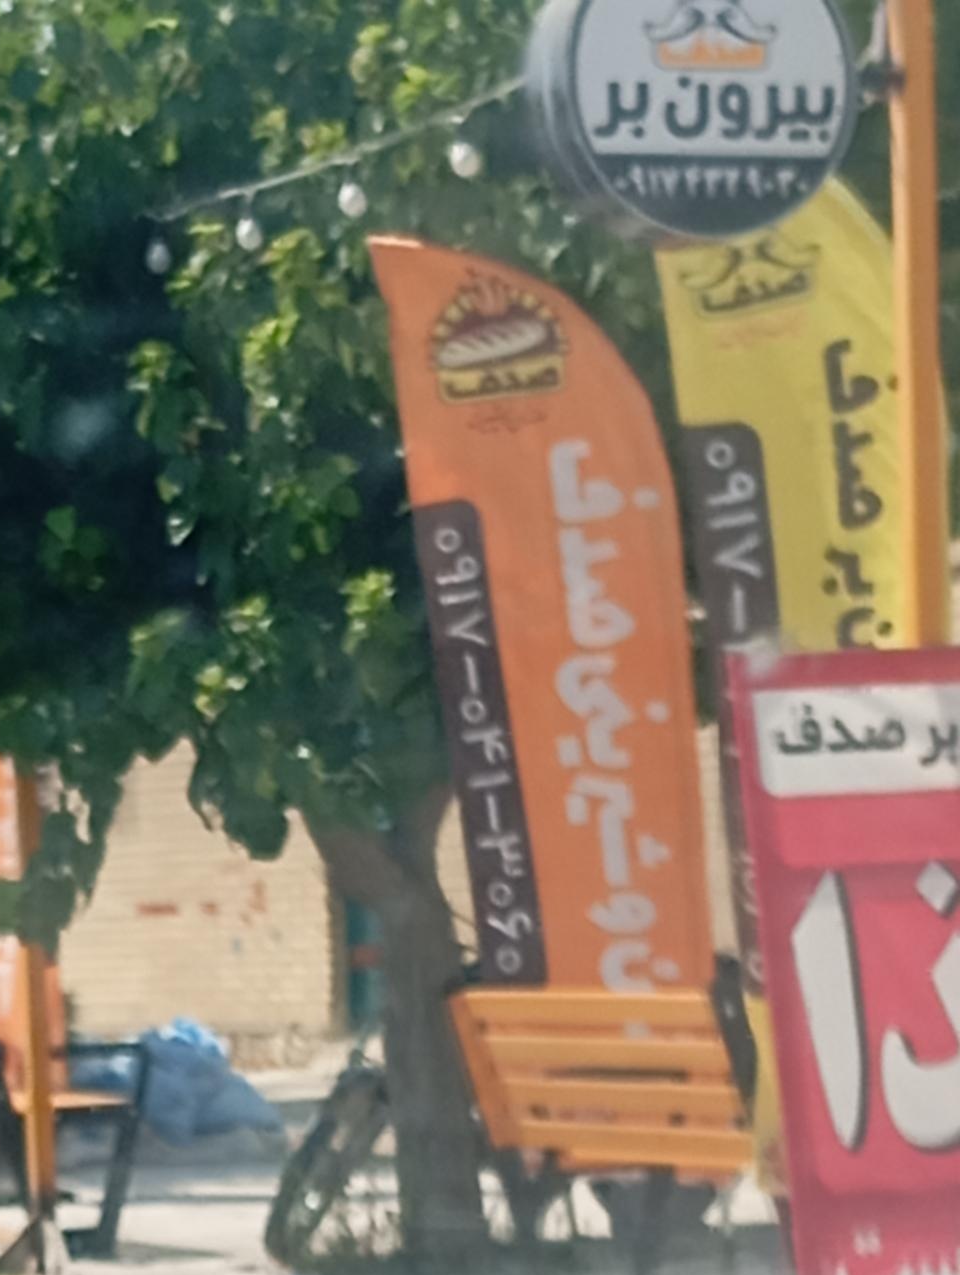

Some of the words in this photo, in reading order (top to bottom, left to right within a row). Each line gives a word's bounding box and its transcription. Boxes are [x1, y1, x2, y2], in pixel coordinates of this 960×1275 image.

[593, 80, 650, 139] بر
[665, 75, 835, 143] بیرون
[823, 338, 898, 530] صدف
[549, 438, 661, 648] صدف
[554, 653, 672, 888] شیرینی
[775, 703, 907, 755] صدف
